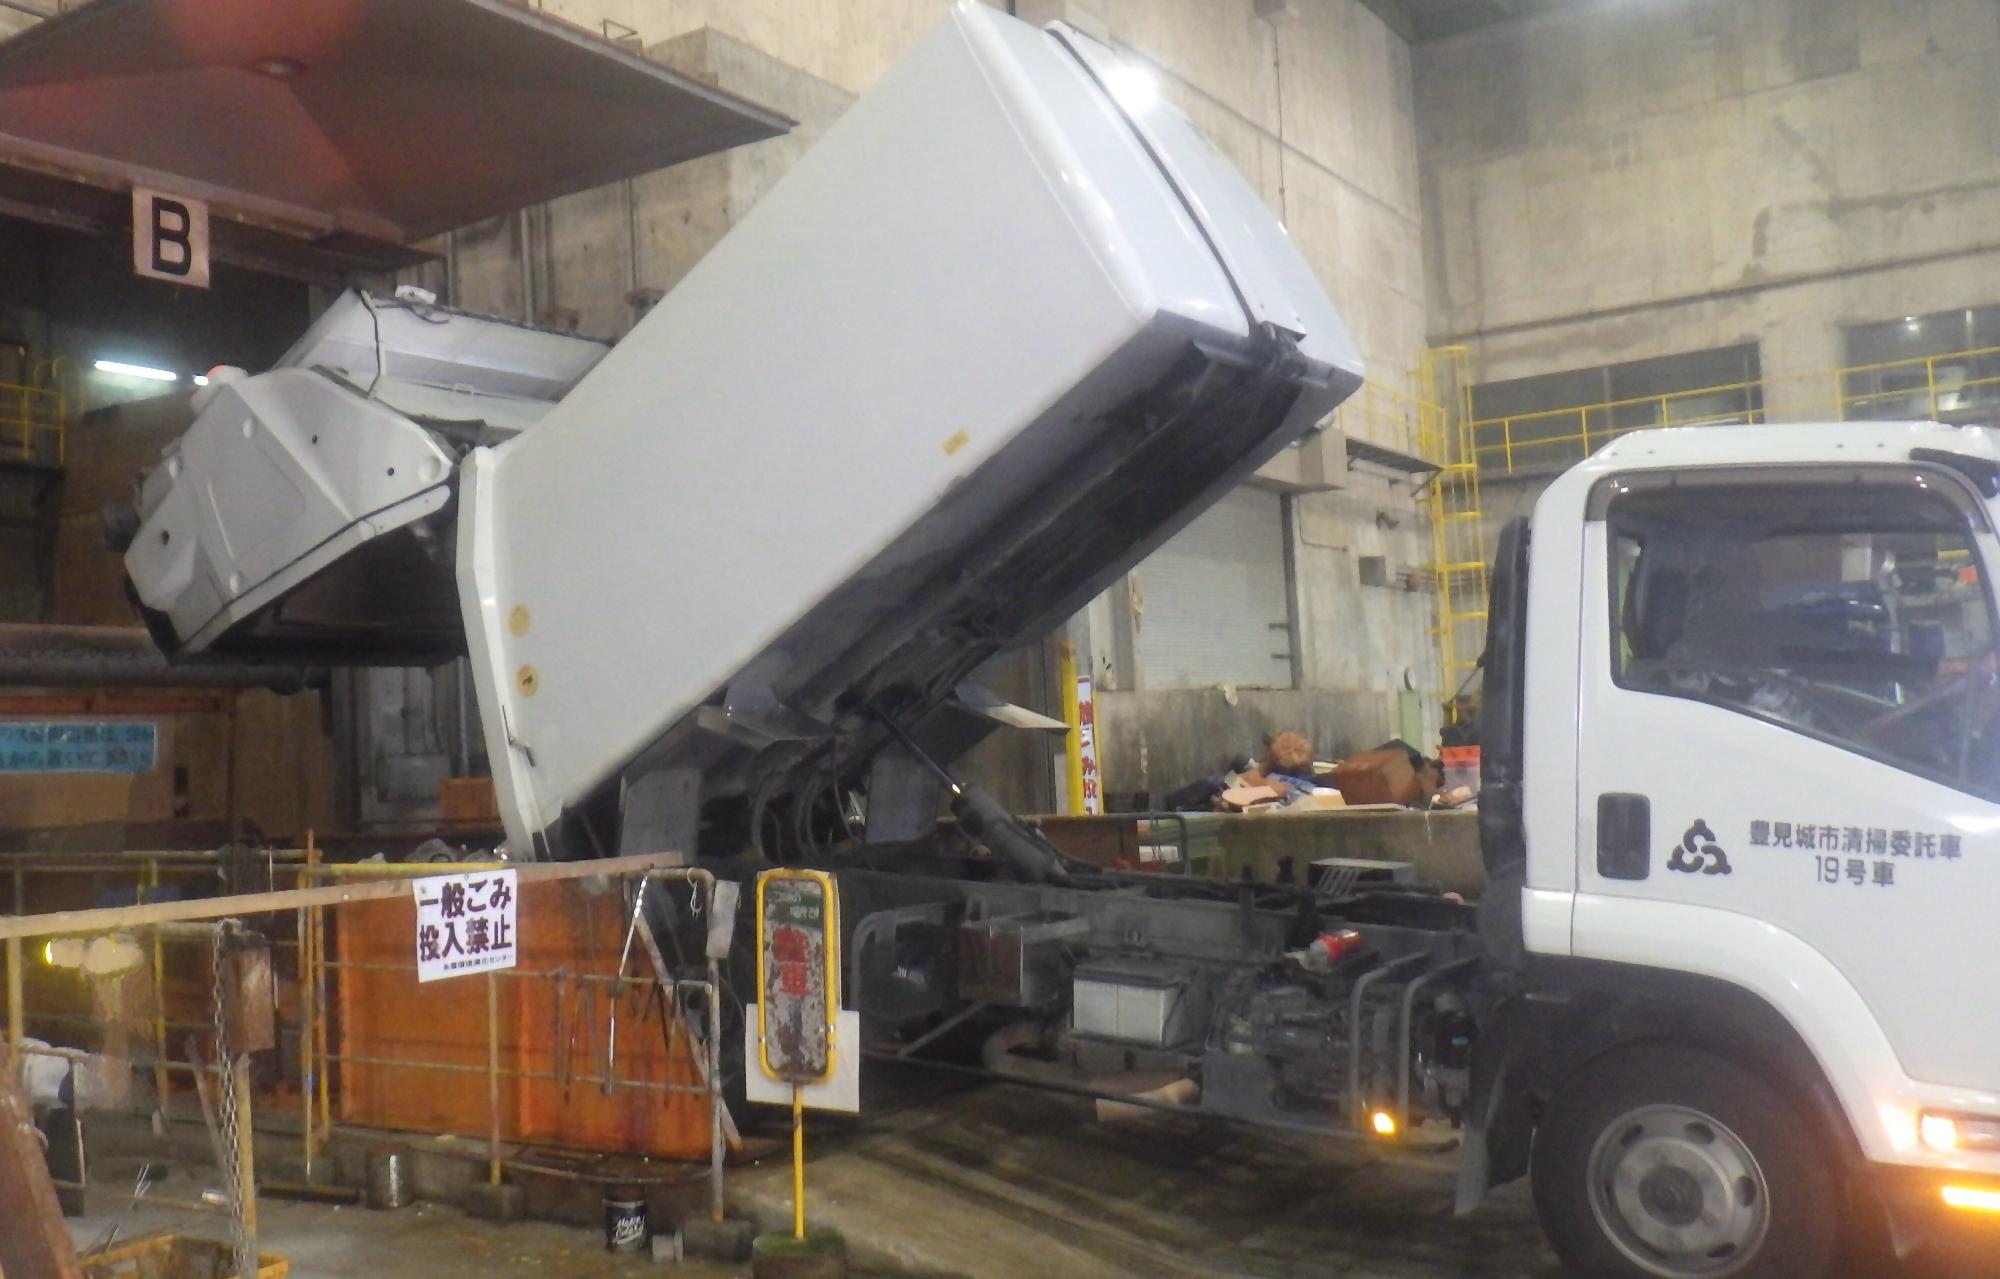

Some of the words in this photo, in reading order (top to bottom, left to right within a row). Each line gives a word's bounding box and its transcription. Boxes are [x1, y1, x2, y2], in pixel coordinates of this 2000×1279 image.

[152, 196, 192, 276] B
[1749, 820, 1962, 860] 豊見城市清掃委託車
[1815, 855, 1895, 888] 19号車
[420, 877, 512, 918] 一般ごみ
[420, 914, 513, 962] 投入禁止
